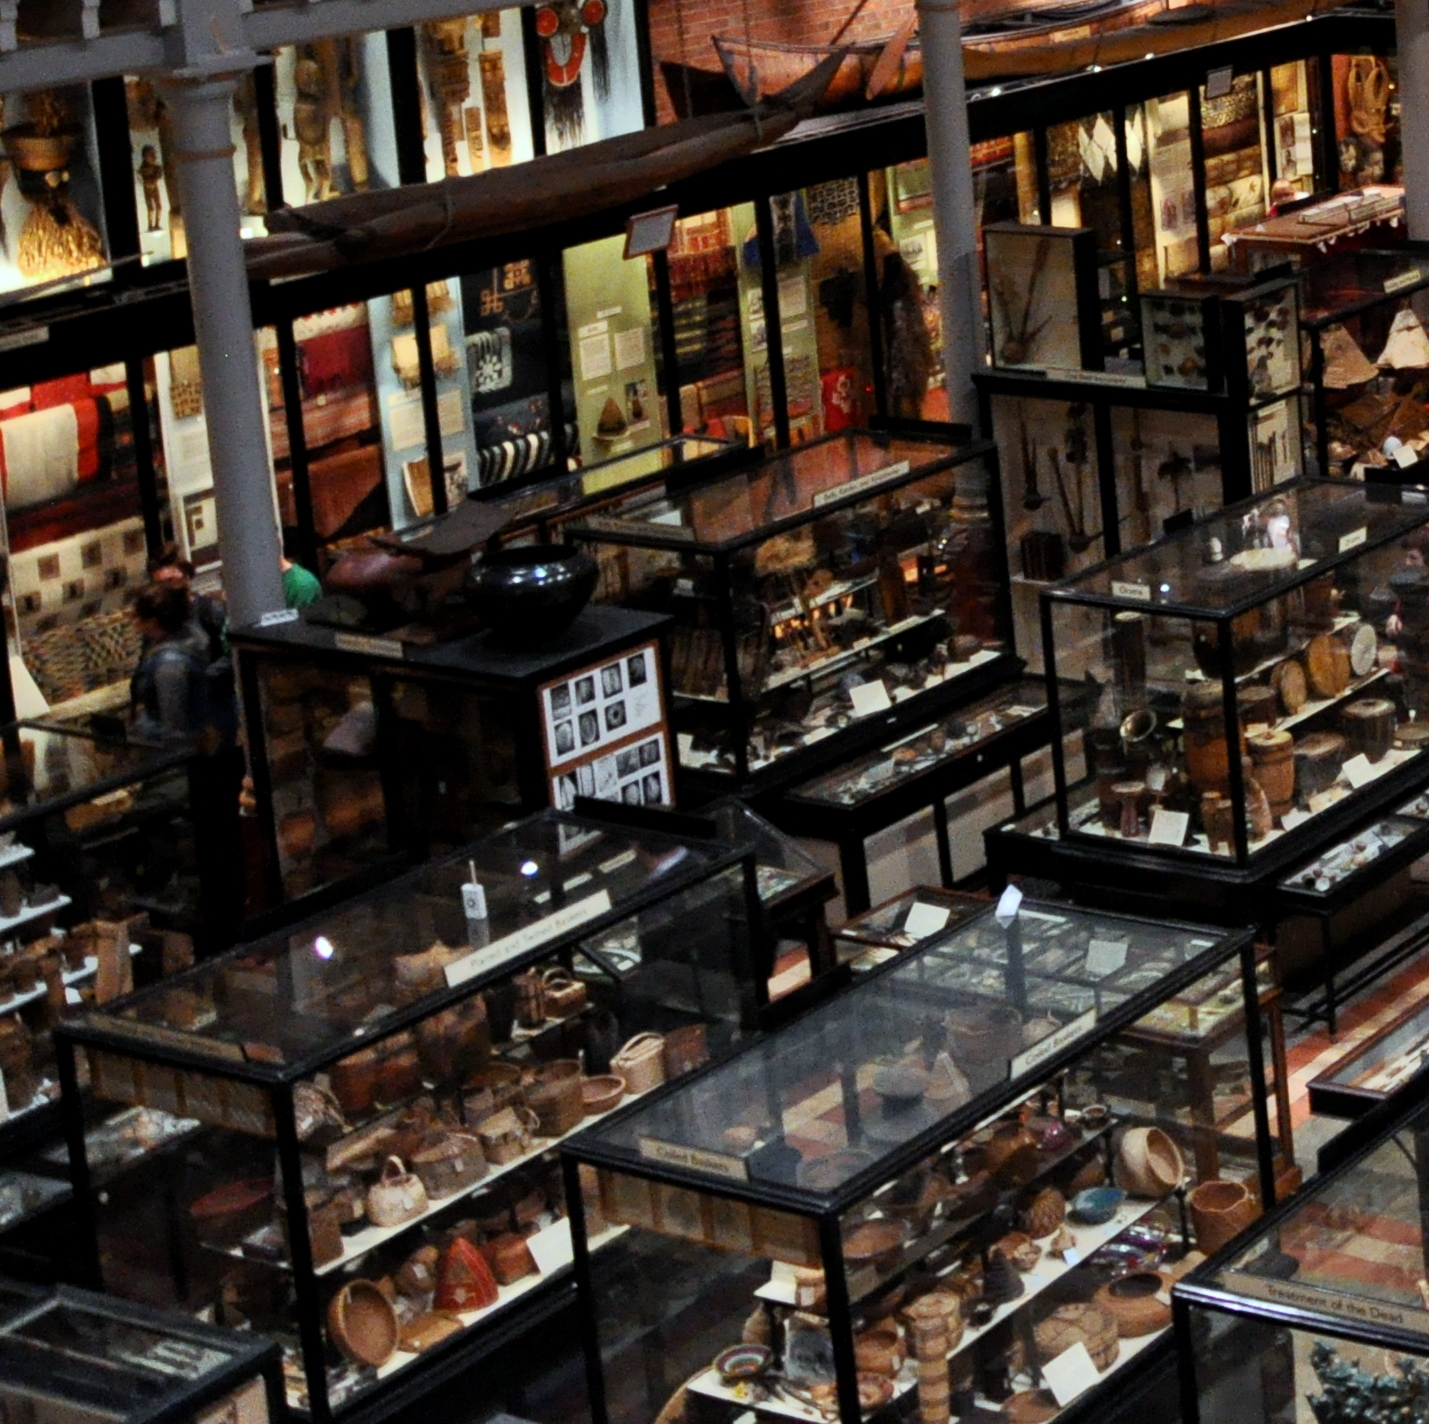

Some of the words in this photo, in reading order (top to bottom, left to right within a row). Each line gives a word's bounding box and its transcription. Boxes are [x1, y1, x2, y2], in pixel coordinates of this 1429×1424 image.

[1267, 1284, 1327, 1307] Treatment
[1330, 1297, 1343, 1310] of
[1345, 1301, 1367, 1316] the
[1370, 1306, 1405, 1324] Dead
